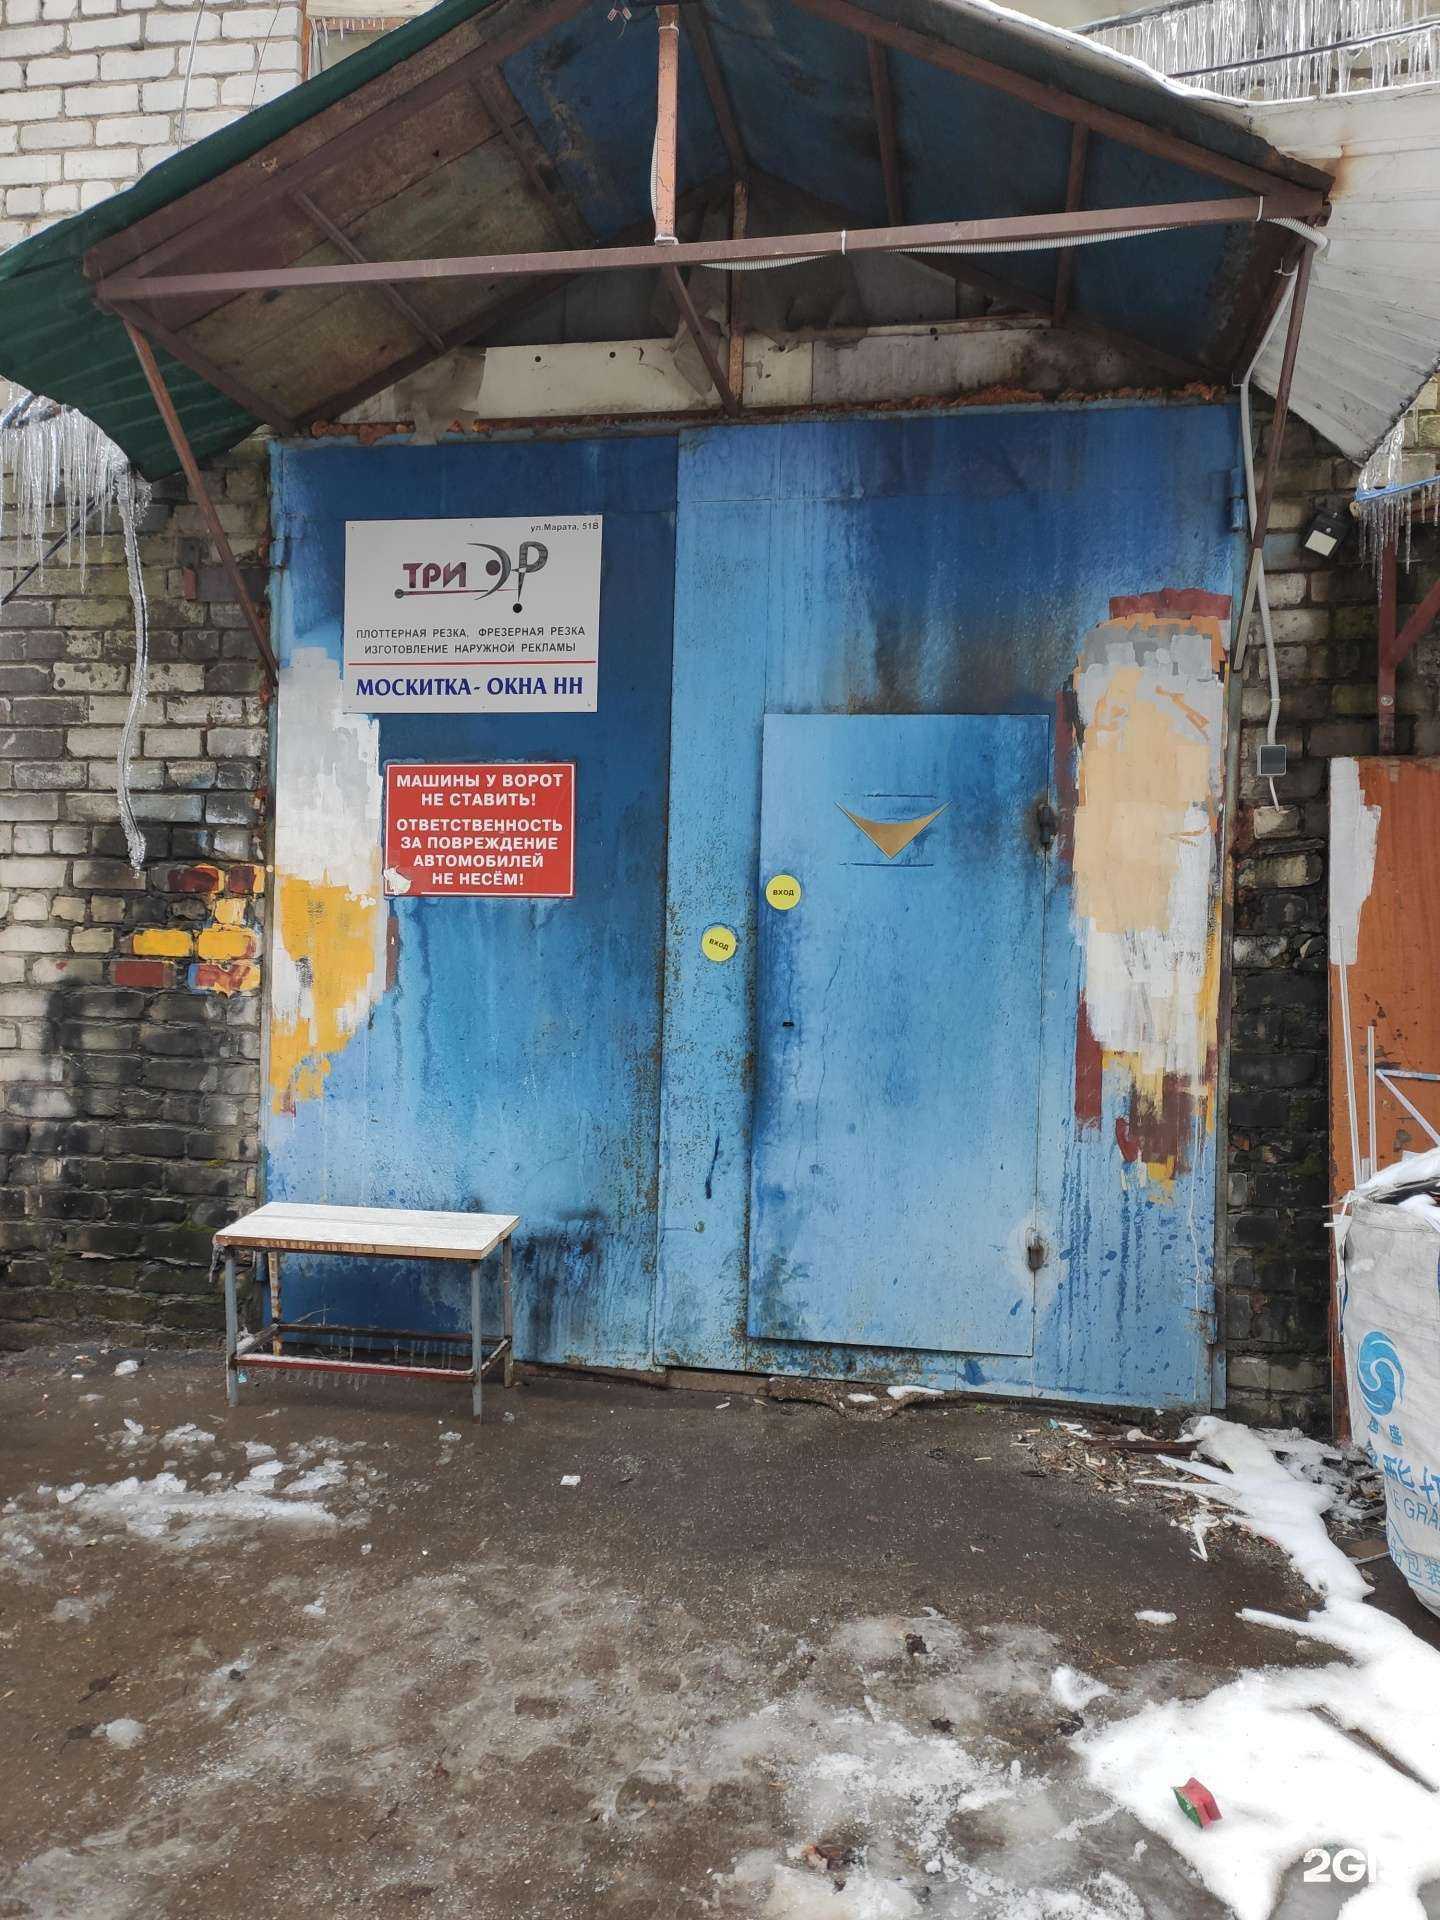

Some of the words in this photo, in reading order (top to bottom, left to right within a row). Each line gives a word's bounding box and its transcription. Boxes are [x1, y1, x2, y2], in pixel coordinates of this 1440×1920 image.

[402, 561, 467, 589] ТРИ
[356, 627, 427, 639] ПЛОТТЕРНАЯ
[432, 628, 469, 640] РЕЗКА,
[478, 626, 544, 637] ФРЕЗЕРНАЯ
[550, 625, 586, 637] РЕЗКА
[364, 644, 449, 655] ИЗГОТОВЛЕНИЕ
[454, 642, 515, 654] НАРУЖНОЙ
[521, 642, 576, 653] РЕКЛАМЫ
[487, 677, 548, 695] ОКНА
[554, 676, 583, 694] НН
[396, 774, 480, 788] МАШИНЫ
[485, 775, 497, 788] У
[502, 773, 564, 788] ВОРОТ
[421, 793, 444, 806] НЕ
[449, 793, 536, 807] СТАВИТЬ!
[396, 818, 563, 832] ОТВЕТСТВЕННОСТЬ
[400, 836, 422, 849] ЗА
[427, 837, 558, 851] ПОВРЕЖДЕНИЕ
[413, 853, 544, 867] АВТОМОБИЛЕЙ
[432, 872, 454, 885] НЕ
[459, 871, 524, 886] НЕСЁМ!
